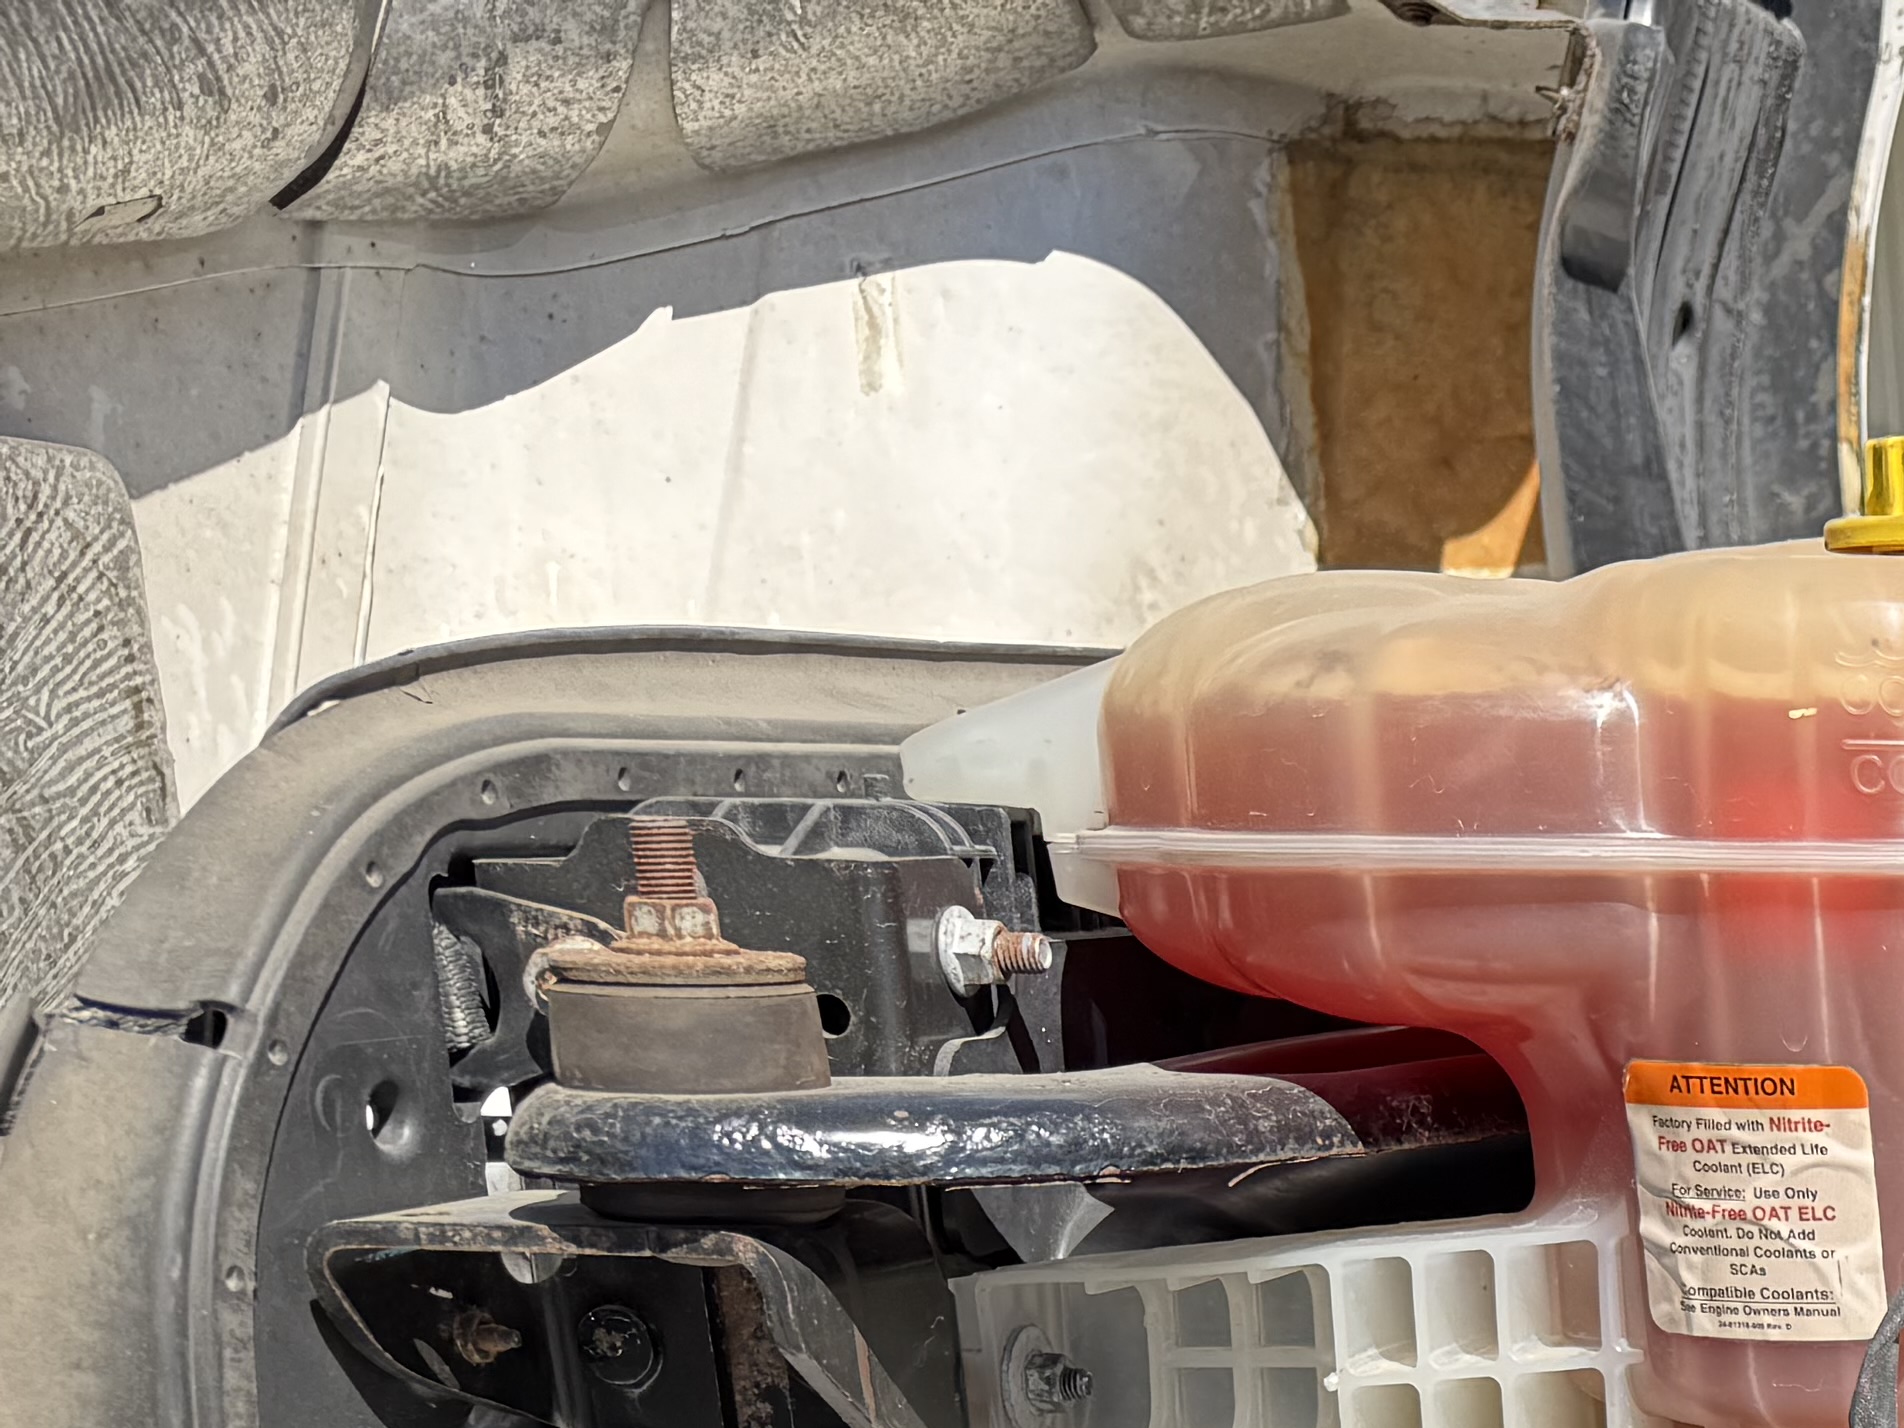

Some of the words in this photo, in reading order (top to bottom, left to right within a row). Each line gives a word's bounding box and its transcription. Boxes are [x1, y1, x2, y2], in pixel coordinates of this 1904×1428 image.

[1669, 1075, 1796, 1096] ATTENTION
[1652, 1115, 1692, 1134] Factory
[1696, 1118, 1732, 1131] Filled
[1735, 1119, 1764, 1132] with
[1769, 1116, 1831, 1133] Nitrite-
[1658, 1136, 1687, 1152] Free
[1691, 1138, 1727, 1154] OAT
[1731, 1142, 1797, 1156] Extended
[1800, 1143, 1828, 1156] Life
[1693, 1160, 1743, 1174] Coolant
[1747, 1163, 1785, 1177] (ELC)
[1671, 1183, 1691, 1197] For
[1694, 1184, 1746, 1199] Service:
[1753, 1186, 1780, 1199] Use
[1784, 1187, 1818, 1202] Only
[1752, 1206, 1792, 1221] OAT
[1798, 1205, 1836, 1221] ELC
[1682, 1225, 1732, 1239] Coolant.
[1736, 1227, 1754, 1240] Do
[1758, 1228, 1783, 1241] Not
[1787, 1229, 1816, 1241] Add
[1669, 1242, 1749, 1258] Conventional
[1754, 1246, 1816, 1259] Coolants
[1821, 1249, 1836, 1259] or
[1729, 1263, 1767, 1276] SCAs
[1759, 1287, 1834, 1301] Coolants:
[1681, 1301, 1696, 1312] See
[1700, 1302, 1740, 1318] Engine
[1743, 1305, 1790, 1317] Owners
[1794, 1306, 1841, 1318] Manual
